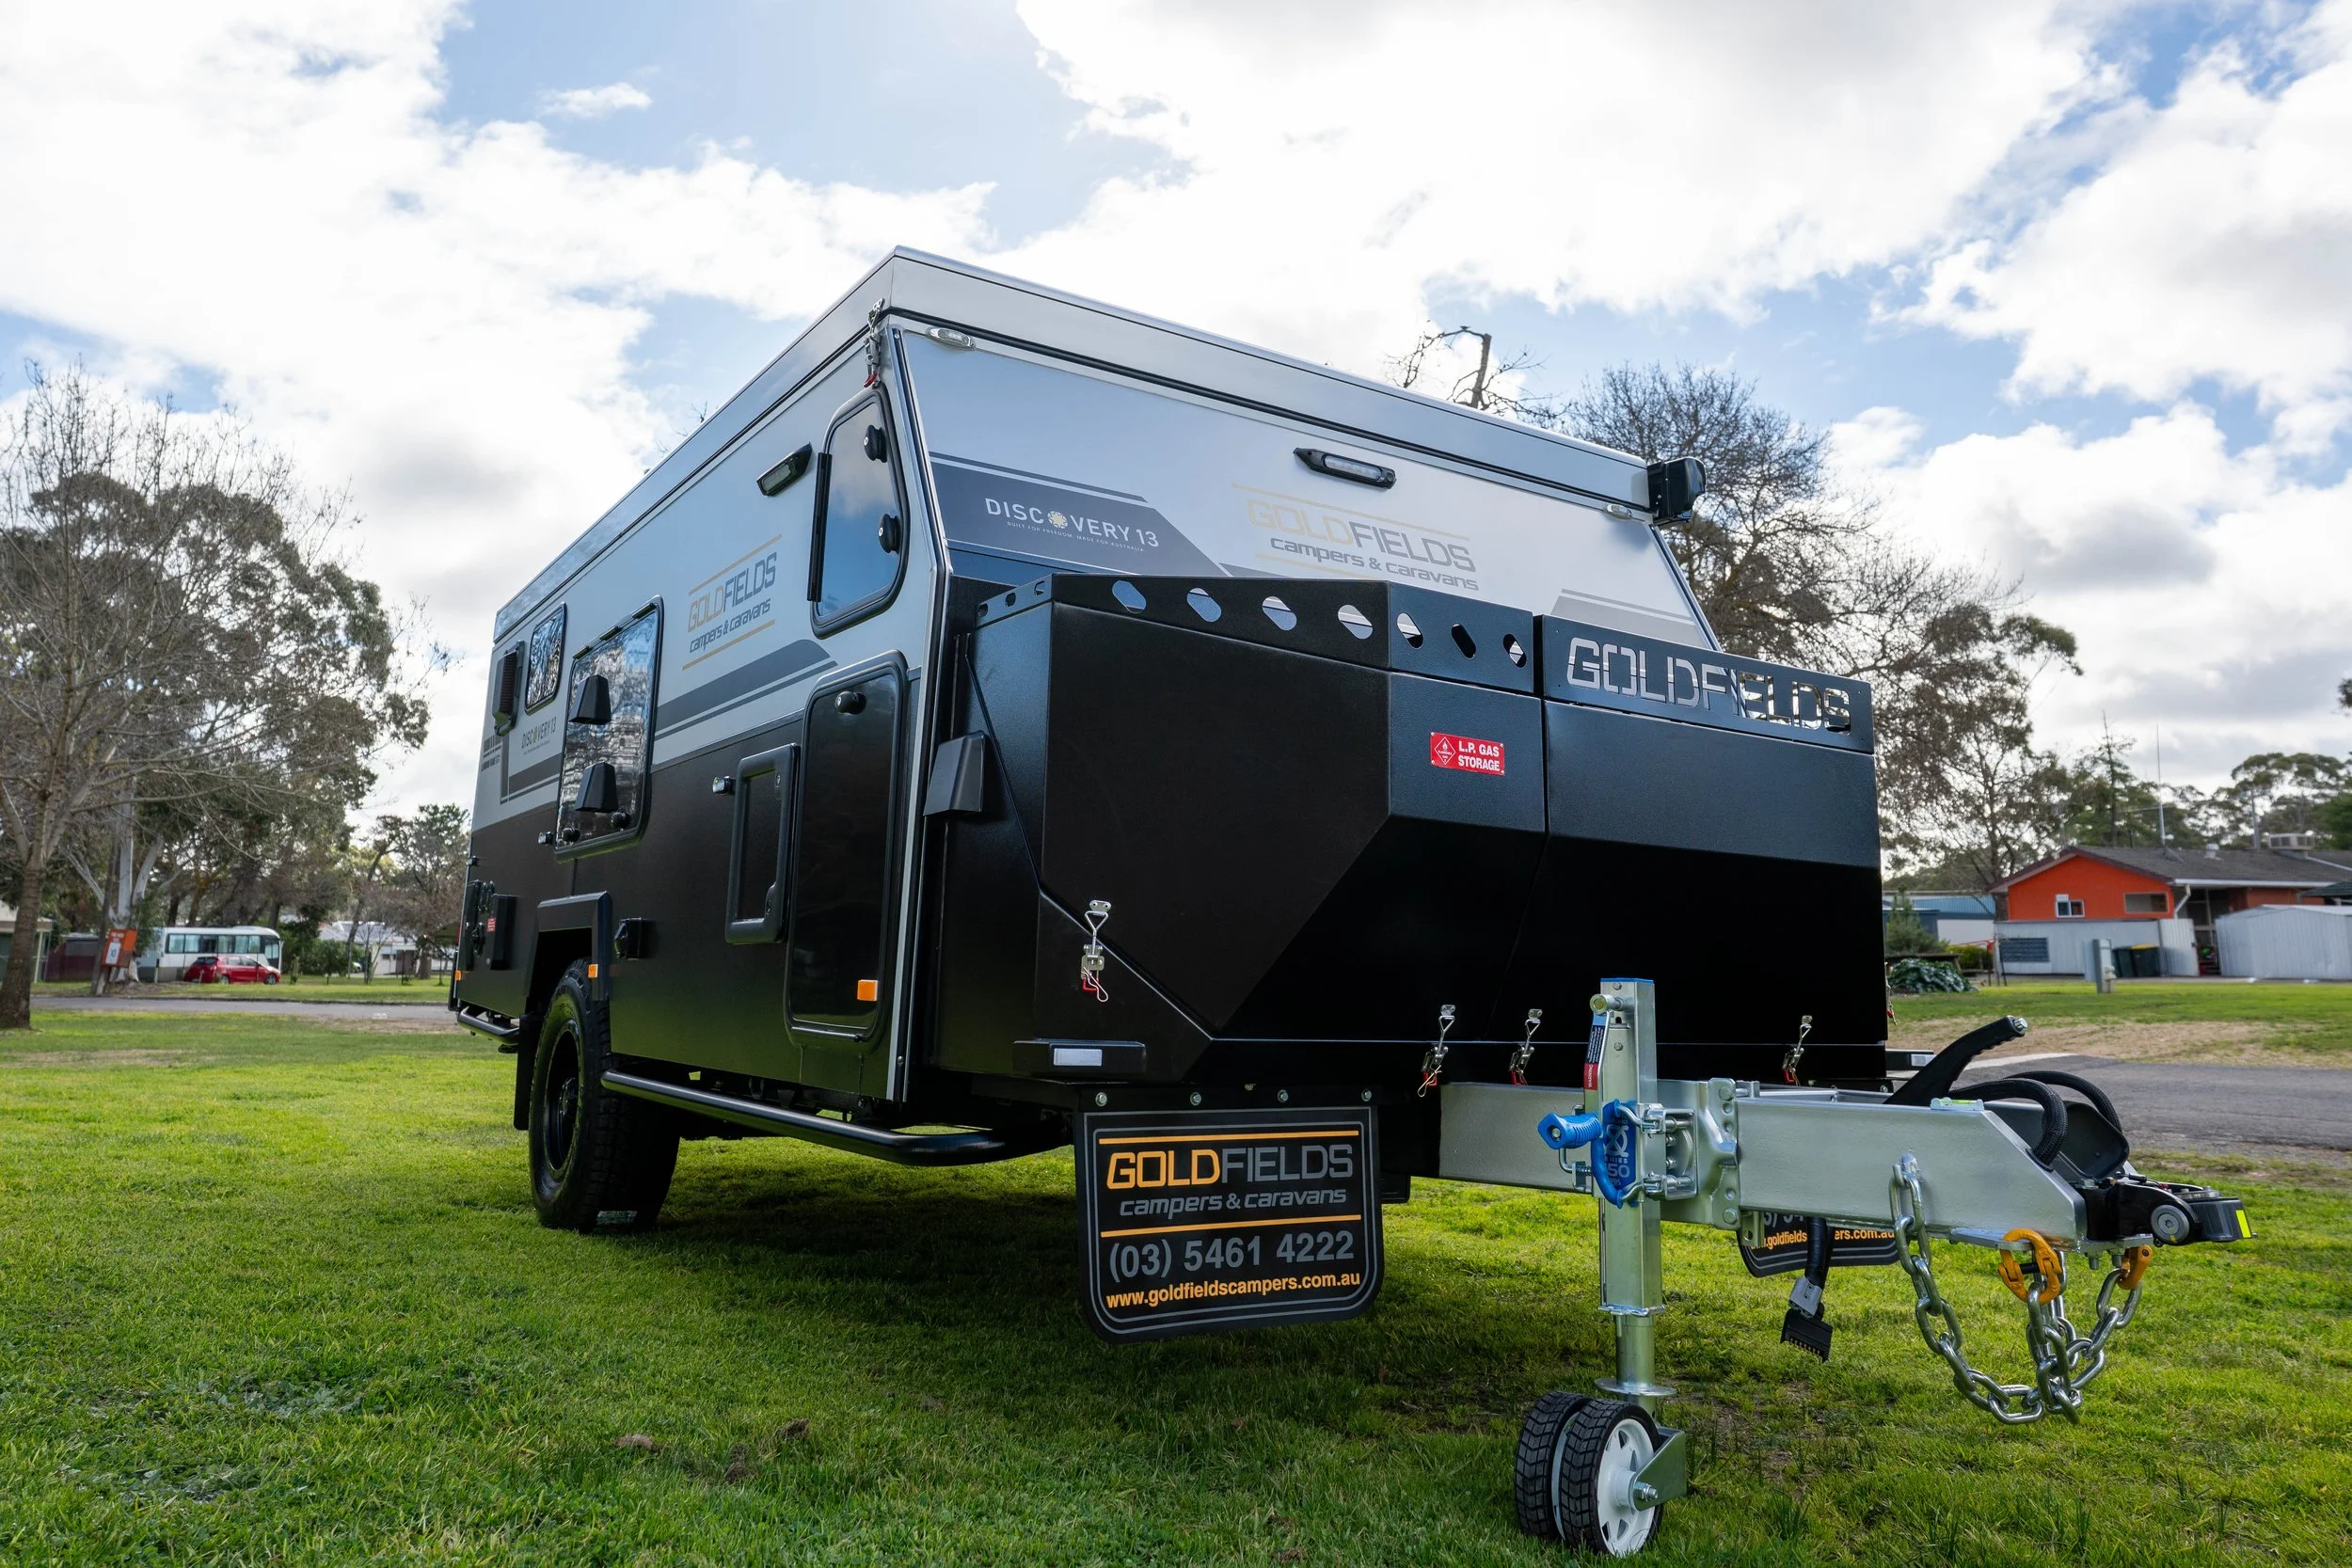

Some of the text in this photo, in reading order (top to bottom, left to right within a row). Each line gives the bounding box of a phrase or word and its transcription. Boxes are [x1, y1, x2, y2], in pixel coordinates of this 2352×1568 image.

[1007, 521, 1025, 530] BUILT
[1076, 534, 1094, 543] MADE
[1110, 542, 1144, 552] AUSTRALIA
[1136, 529, 1159, 547] 13
[1247, 499, 1476, 573] GOLDFIELDS
[1270, 537, 1479, 592] campers & caravans
[688, 551, 777, 633] GOLDFIELDS
[689, 597, 771, 654] campers & caravans
[1566, 637, 1851, 736] GOLDFIELDS
[1457, 754, 1501, 771] STORAGE
[1458, 740, 1500, 757] L.P. GAS
[1105, 1144, 1353, 1190] GOLDFIELDS
[1120, 1188, 1347, 1220] campers & caravans
[1109, 1229, 1355, 1283] (03) 5461 4222
[1105, 1271, 1360, 1308] www.goldfieldscampers.com.au
